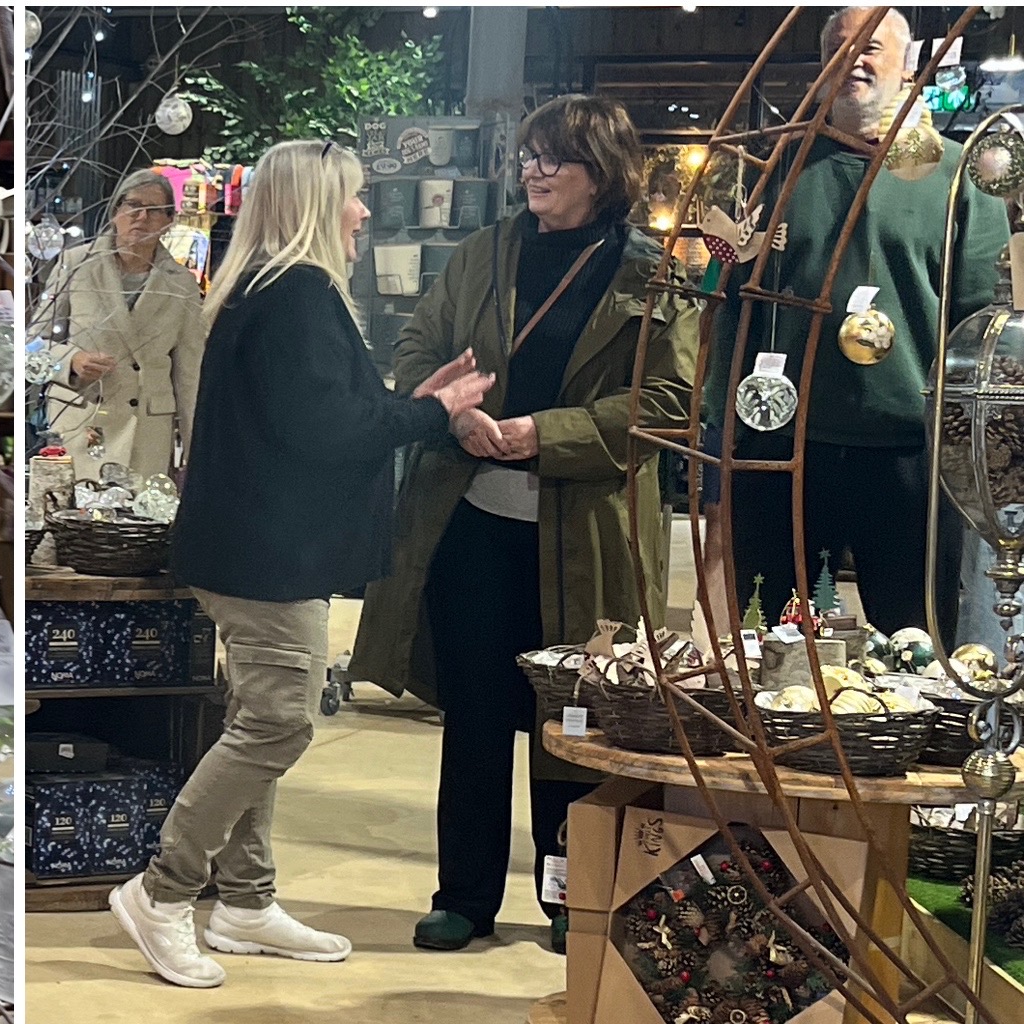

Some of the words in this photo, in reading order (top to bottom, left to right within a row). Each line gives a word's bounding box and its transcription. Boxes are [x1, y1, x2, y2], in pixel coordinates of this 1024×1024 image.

[52, 629, 76, 641] 240
[135, 628, 158, 640] 240
[149, 799, 166, 808] 120
[54, 817, 73, 826] 120
[110, 813, 128, 823] 120
[643, 817, 665, 857] KINGS
